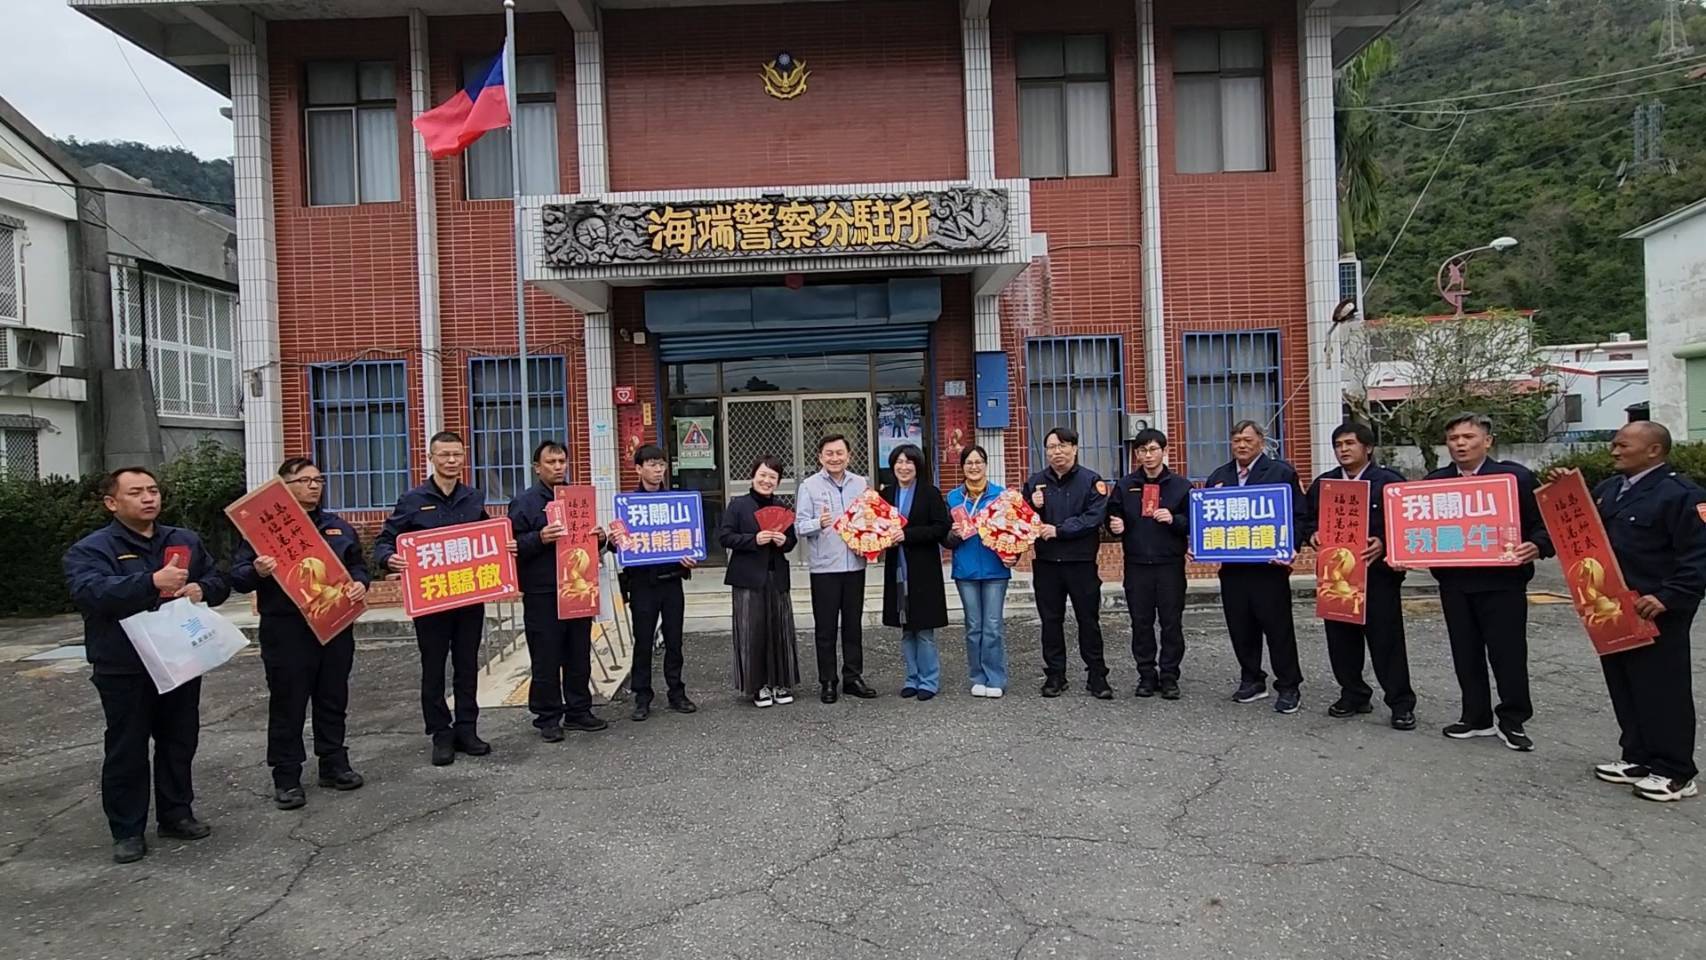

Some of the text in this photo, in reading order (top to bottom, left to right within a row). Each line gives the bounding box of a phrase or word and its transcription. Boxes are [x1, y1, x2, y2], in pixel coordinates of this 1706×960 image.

[648, 199, 931, 254] 海端警察分駐所
